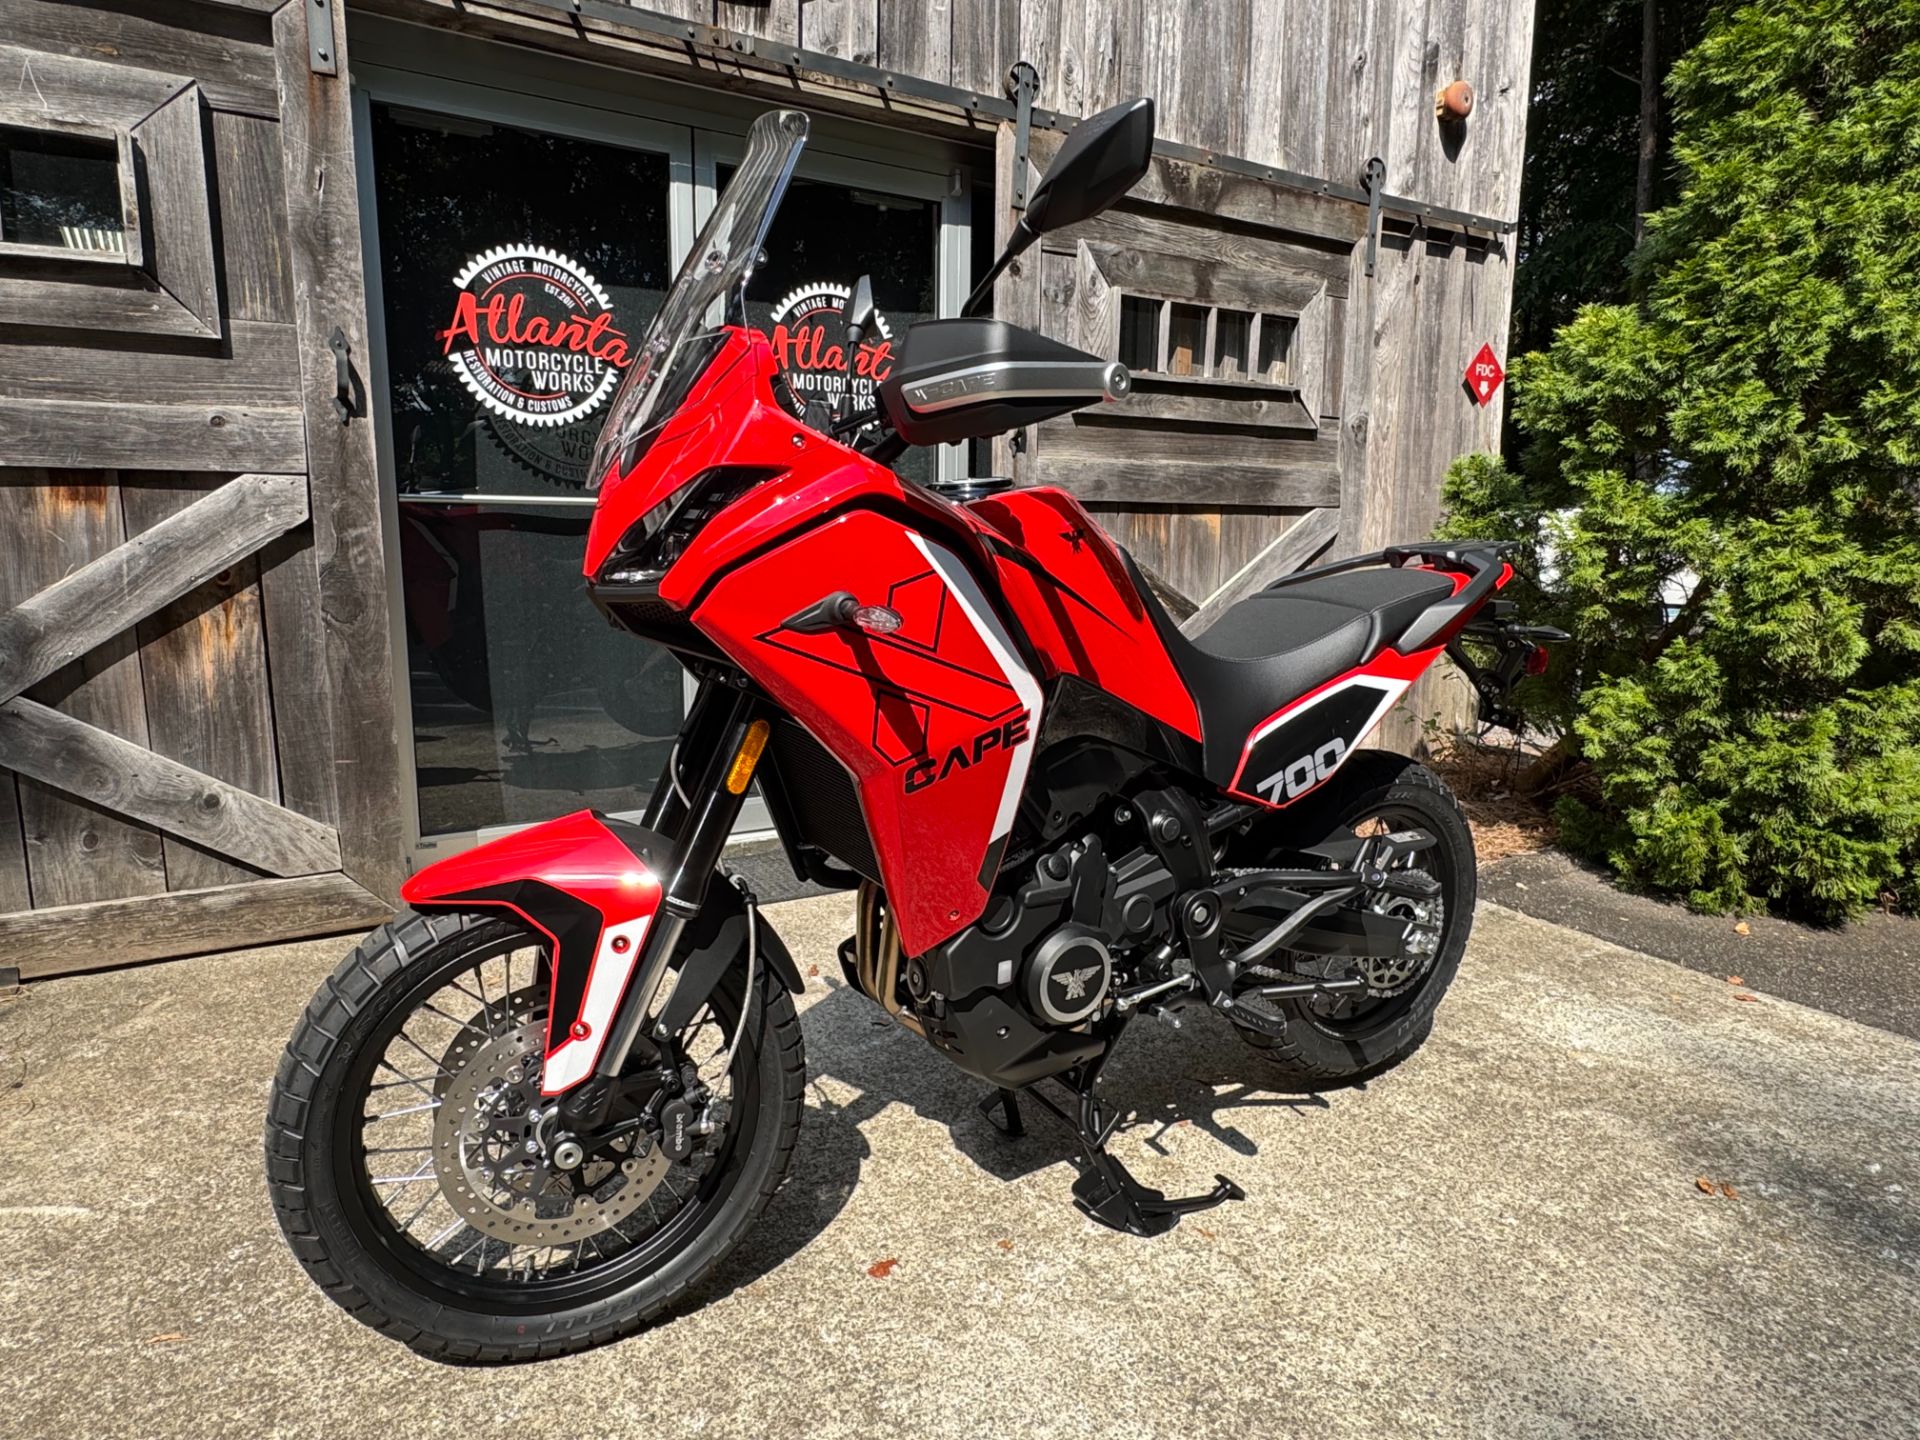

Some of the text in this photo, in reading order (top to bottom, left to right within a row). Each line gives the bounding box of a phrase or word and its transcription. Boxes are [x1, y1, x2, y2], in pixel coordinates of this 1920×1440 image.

[481, 260, 595, 307] VINTAGE MOTORCYCLE
[792, 296, 827, 318] VINTAGE
[440, 291, 633, 368] Atlanta
[485, 347, 604, 375] MOTORCYCLE
[771, 324, 895, 382] Atlant
[1475, 363, 1495, 378] FDC
[463, 350, 516, 405] RESTORATION
[527, 396, 573, 413] CUSTOMS
[531, 370, 594, 393] WORKS
[827, 392, 876, 411] WRKS
[904, 708, 1031, 795] CAPE
[1256, 737, 1346, 805] 700
[675, 1113, 686, 1152] brembo
